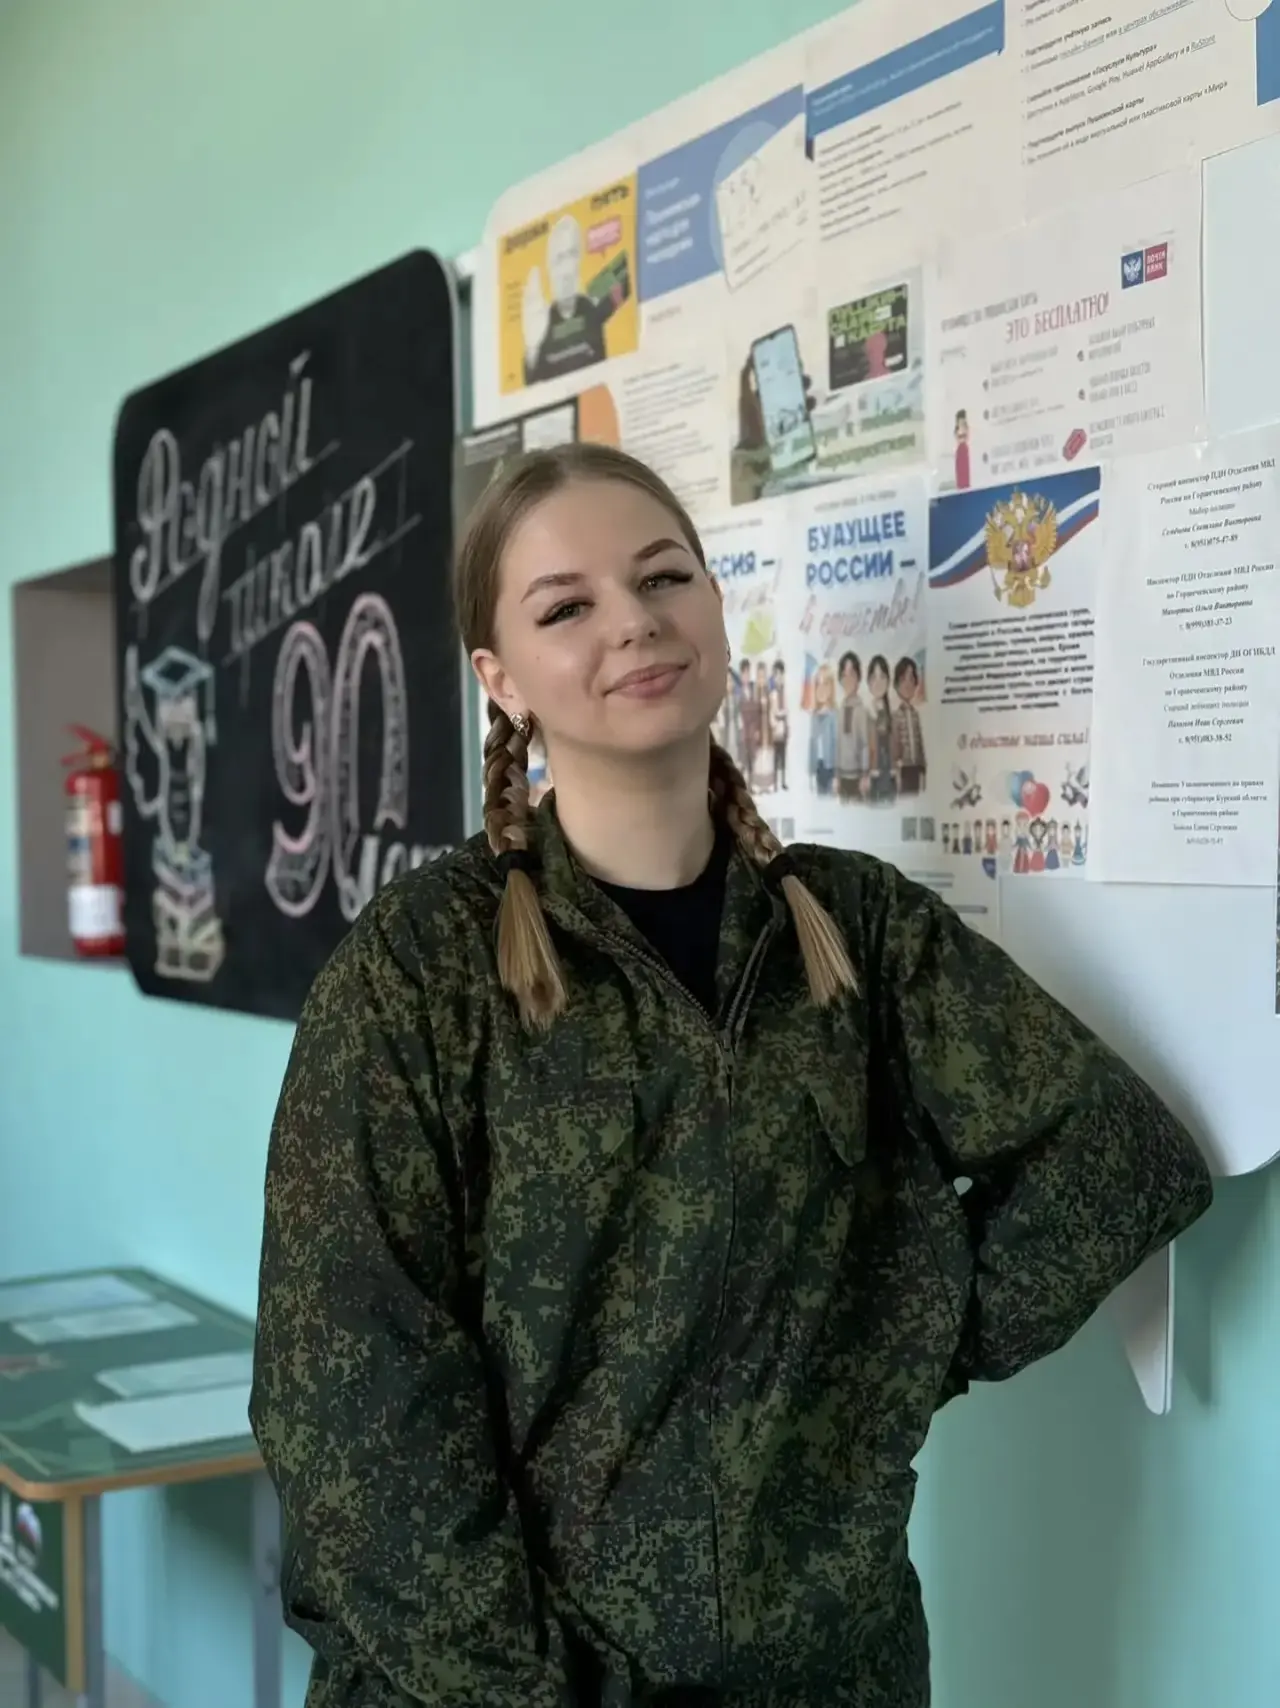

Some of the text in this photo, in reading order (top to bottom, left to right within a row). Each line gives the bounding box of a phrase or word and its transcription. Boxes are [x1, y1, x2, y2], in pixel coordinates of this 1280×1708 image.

[1005, 316, 1029, 343] ЭТО
[1034, 291, 1109, 336] БЕСПЛАТНО!
[808, 510, 905, 551] БУДУЩЕЕ
[806, 549, 893, 585] РОССИИ
[265, 593, 408, 917] 90
